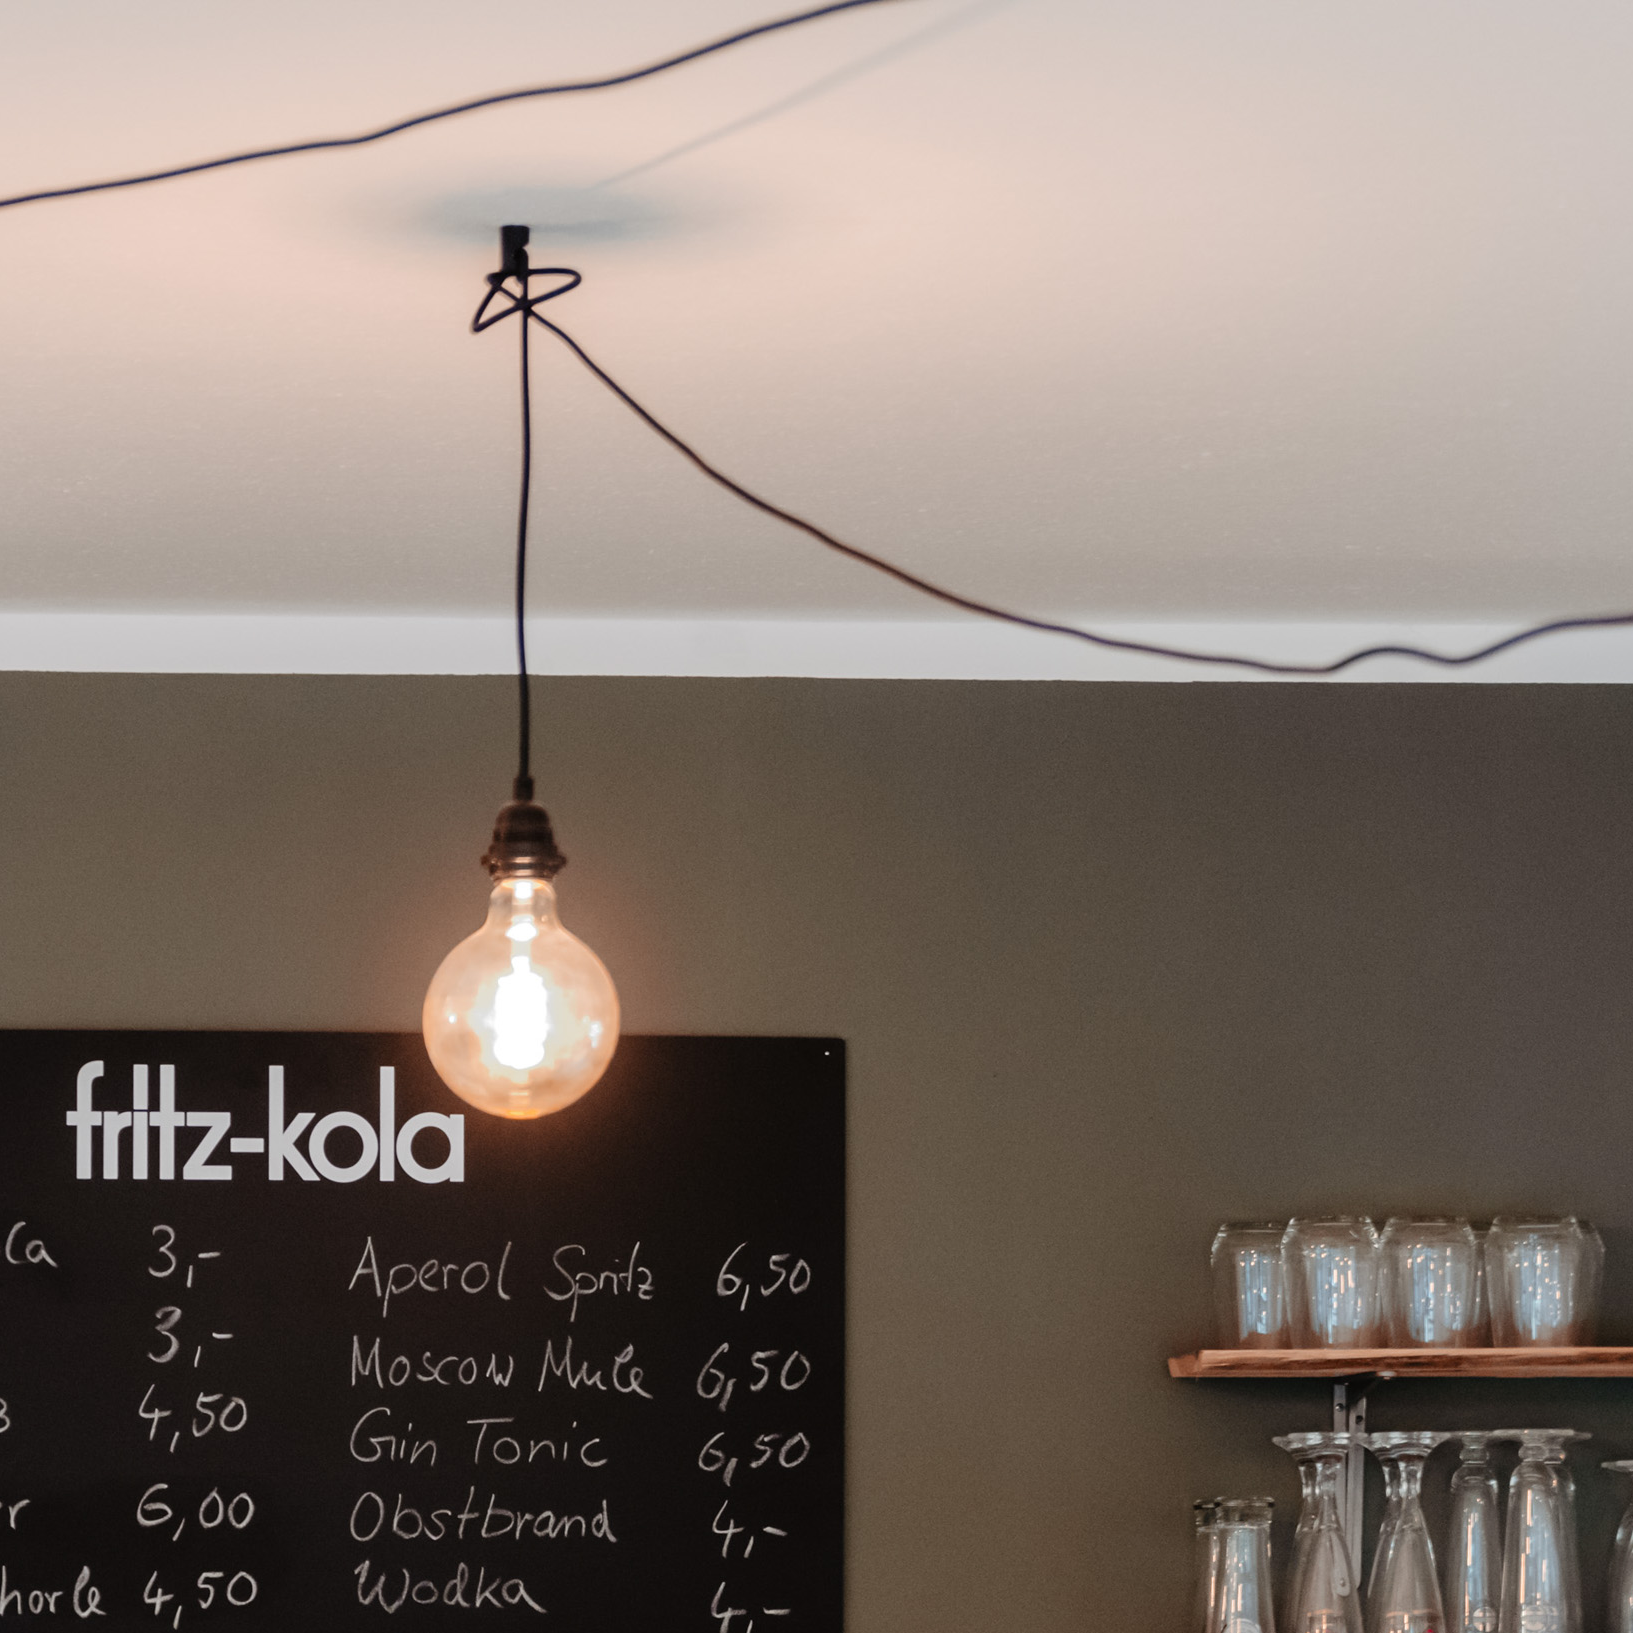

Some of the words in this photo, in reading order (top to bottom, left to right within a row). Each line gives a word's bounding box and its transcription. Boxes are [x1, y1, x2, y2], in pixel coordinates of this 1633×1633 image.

[66, 1061, 465, 1183] fritz-kola
[349, 1236, 511, 1318] Aperol
[544, 1241, 653, 1322] Spritz
[717, 1243, 810, 1311] 6,50
[352, 1335, 514, 1388] Moscow
[538, 1336, 652, 1398] Mule
[697, 1343, 810, 1411] 6,50
[139, 1384, 247, 1453] 4,50
[350, 1407, 436, 1466] Gin
[467, 1418, 607, 1467] Tonic
[698, 1432, 810, 1486] 6,50
[137, 1483, 255, 1541] 6,00
[350, 1486, 616, 1542] Obstbrand
[143, 1571, 257, 1629] 4,50
[354, 1560, 546, 1614] Wodka
